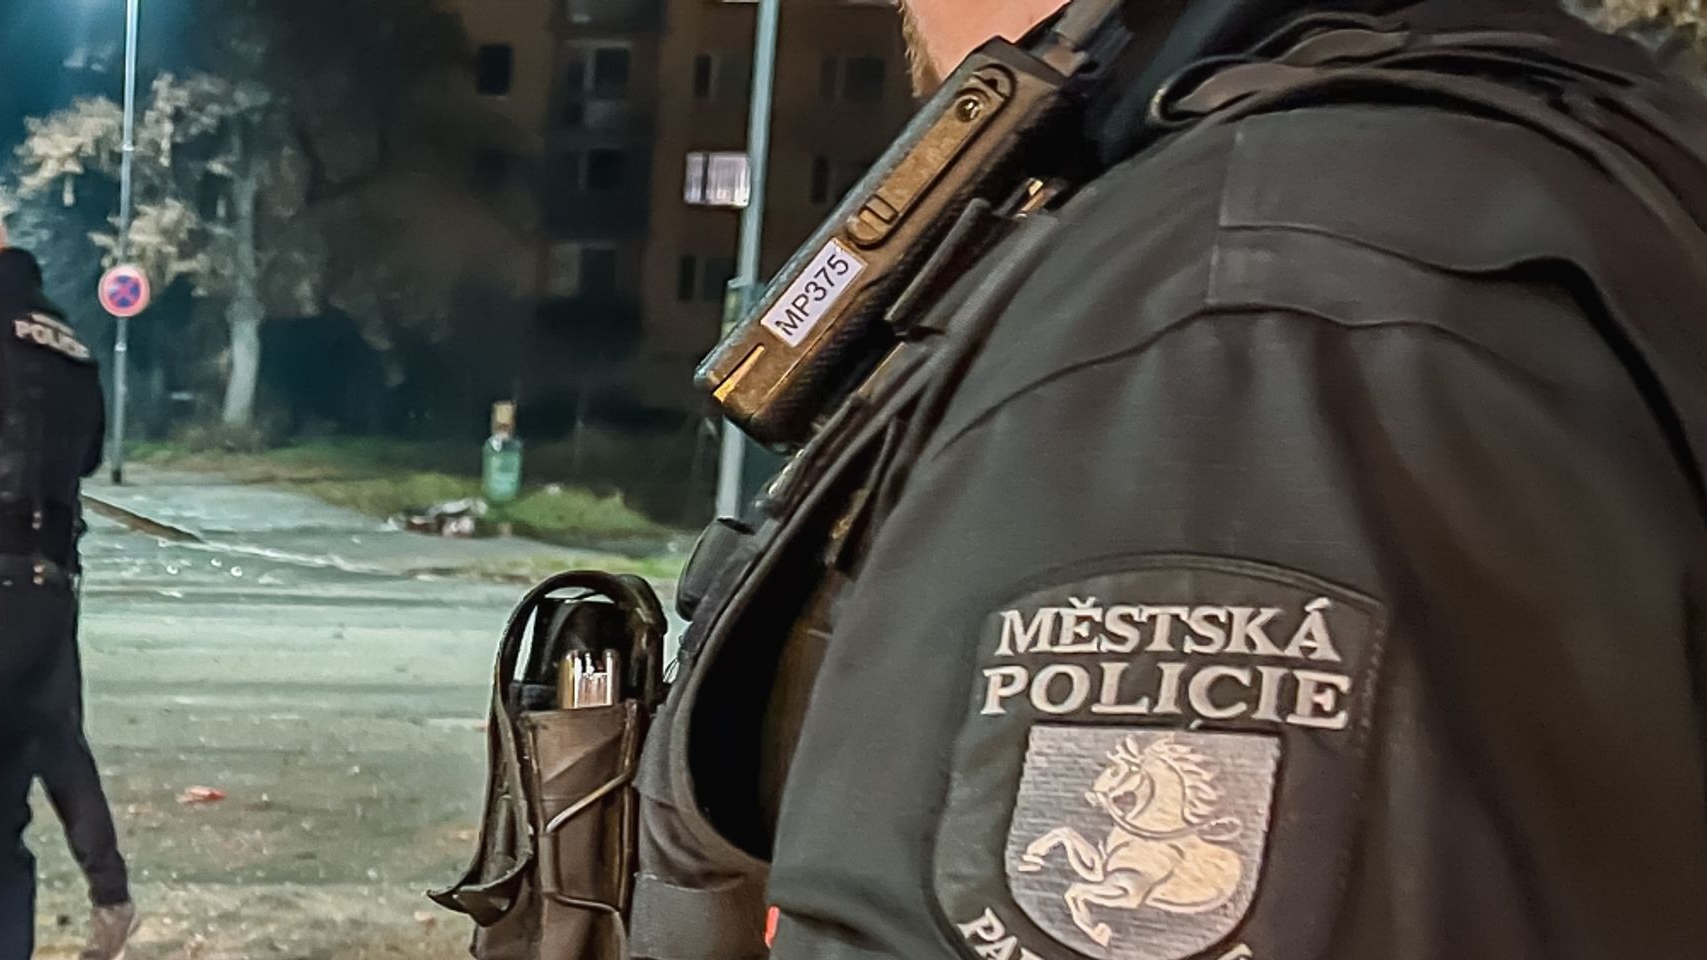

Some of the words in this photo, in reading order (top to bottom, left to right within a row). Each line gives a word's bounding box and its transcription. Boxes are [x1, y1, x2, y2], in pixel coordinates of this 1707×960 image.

[775, 254, 849, 336] MP375
[996, 597, 1342, 662] MĚSTSKÁ
[980, 662, 1352, 730] POLICIE
